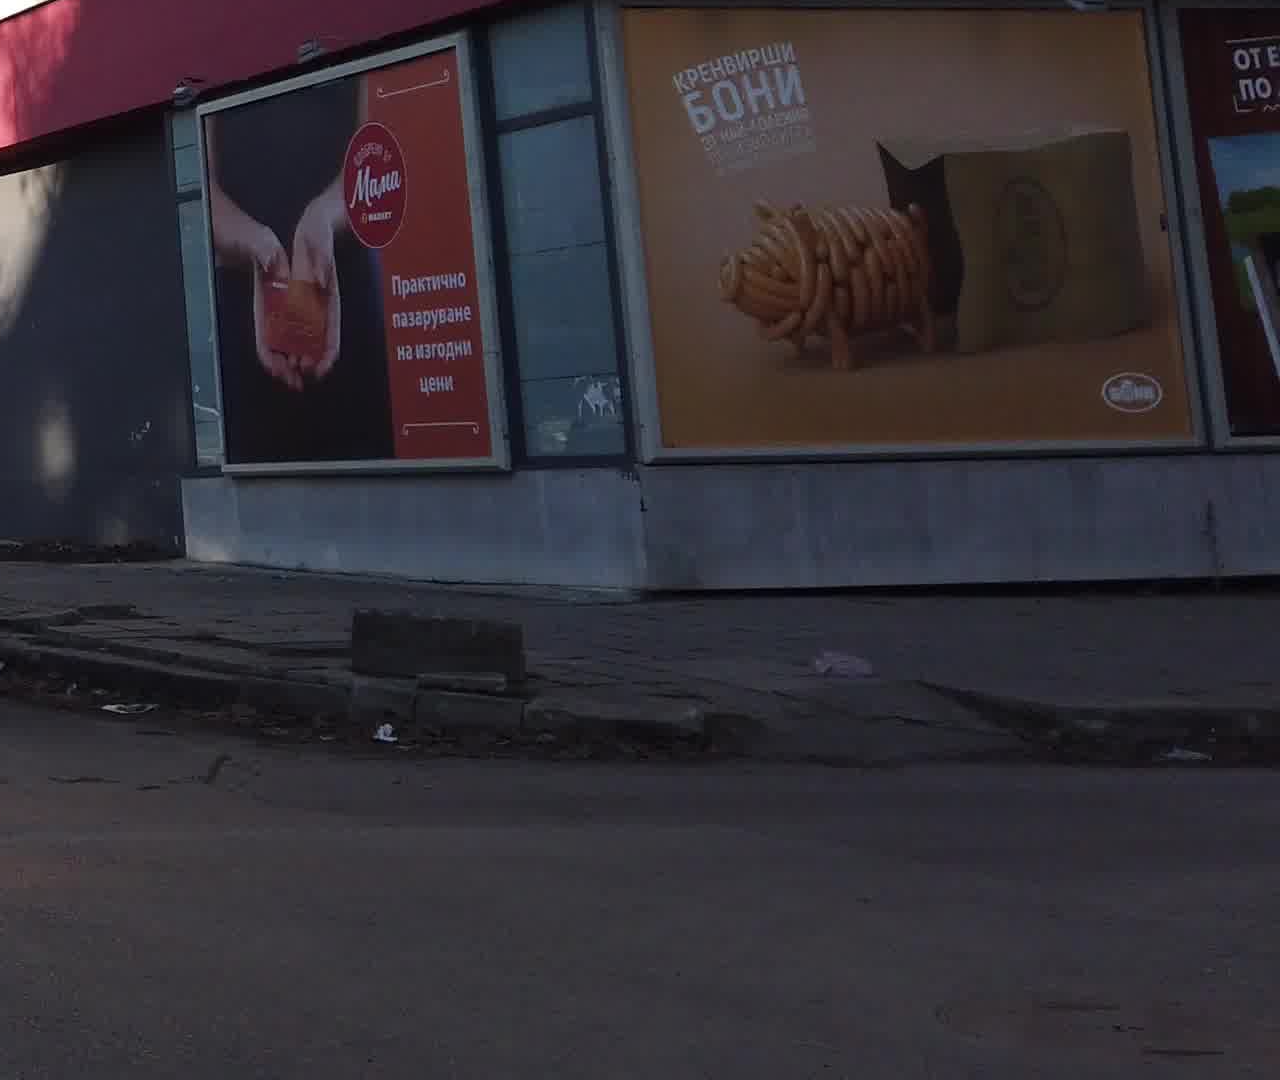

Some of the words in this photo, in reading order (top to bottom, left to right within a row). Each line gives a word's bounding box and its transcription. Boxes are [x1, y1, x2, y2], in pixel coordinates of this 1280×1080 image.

[672, 40, 795, 93] КРЕНВИРШИ
[1233, 47, 1261, 70] ОТ
[682, 67, 806, 133] БОНИ
[1239, 77, 1272, 102] ПО
[350, 165, 401, 209] Мама
[391, 272, 466, 300] Практично
[392, 305, 472, 331] пазаруване
[396, 344, 413, 361] на
[415, 339, 473, 362] изгодни
[419, 375, 454, 397] цени
